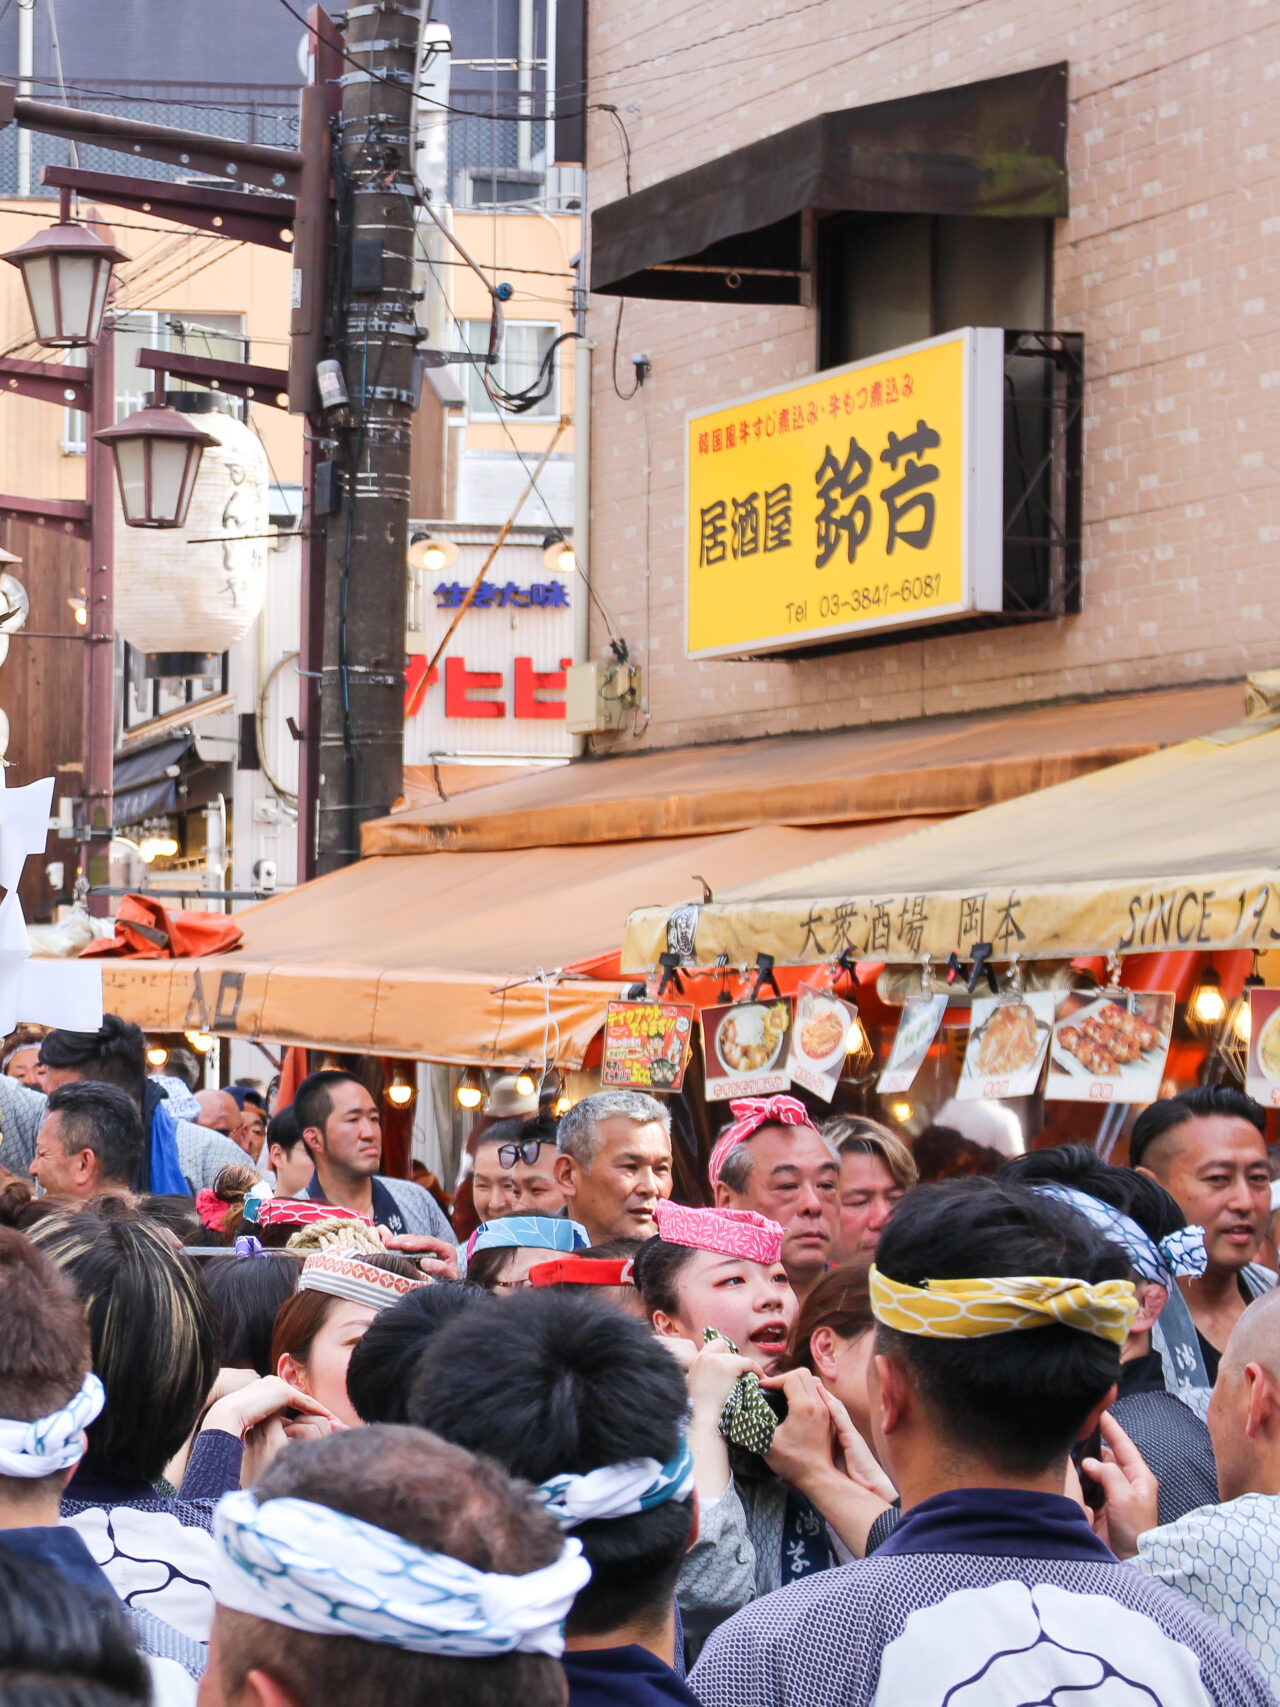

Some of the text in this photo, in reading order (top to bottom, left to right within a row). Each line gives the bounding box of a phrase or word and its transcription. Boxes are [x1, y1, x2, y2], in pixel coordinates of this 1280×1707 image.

[699, 419, 940, 569] 居酒屋 鈴芳
[433, 580, 570, 609] 生きた味
[786, 573, 941, 624] Tel 03-3841-6081
[799, 889, 1026, 957] 大衆酒場 岡本
[1119, 886, 1280, 949] SINCE 19
